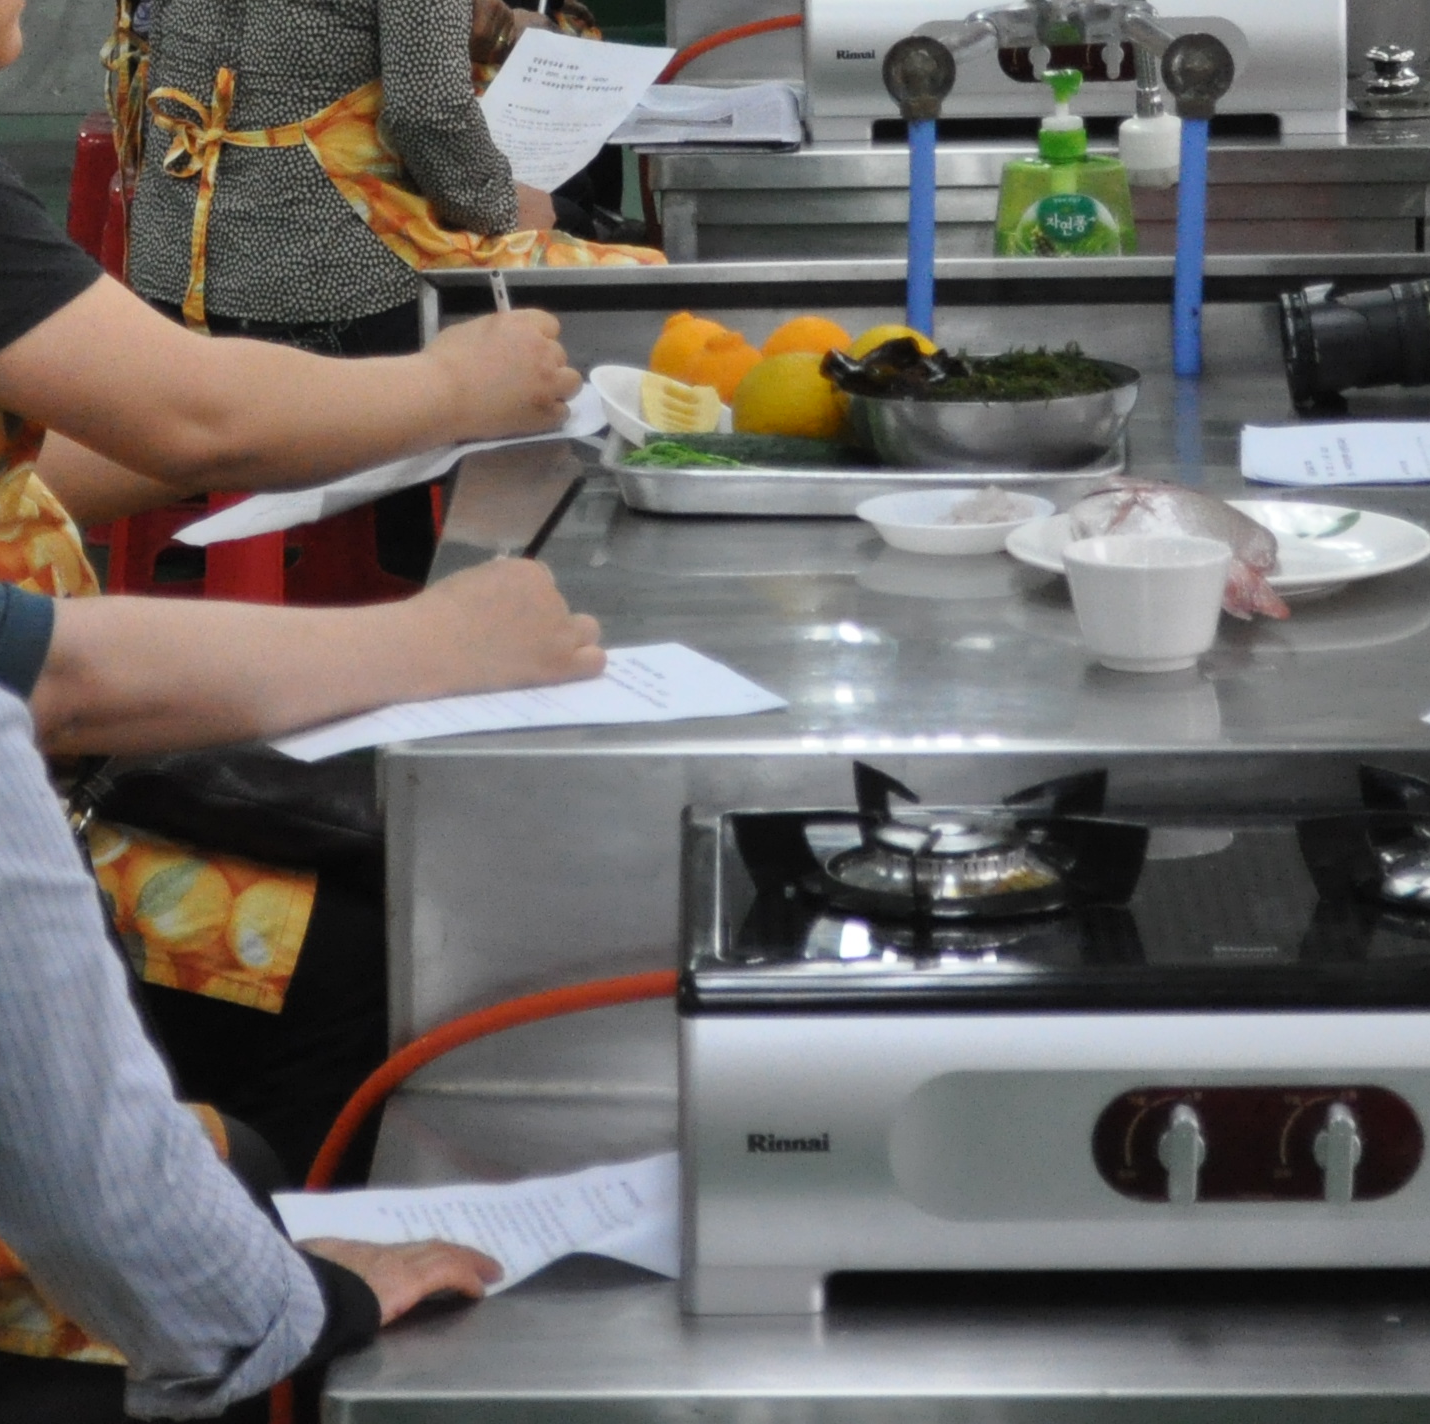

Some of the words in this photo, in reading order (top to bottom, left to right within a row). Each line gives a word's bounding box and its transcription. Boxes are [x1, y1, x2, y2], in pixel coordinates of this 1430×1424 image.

[836, 49, 876, 60] Rinnai
[1046, 213, 1087, 237] 자연퐁
[747, 1133, 830, 1153] Rinnai
